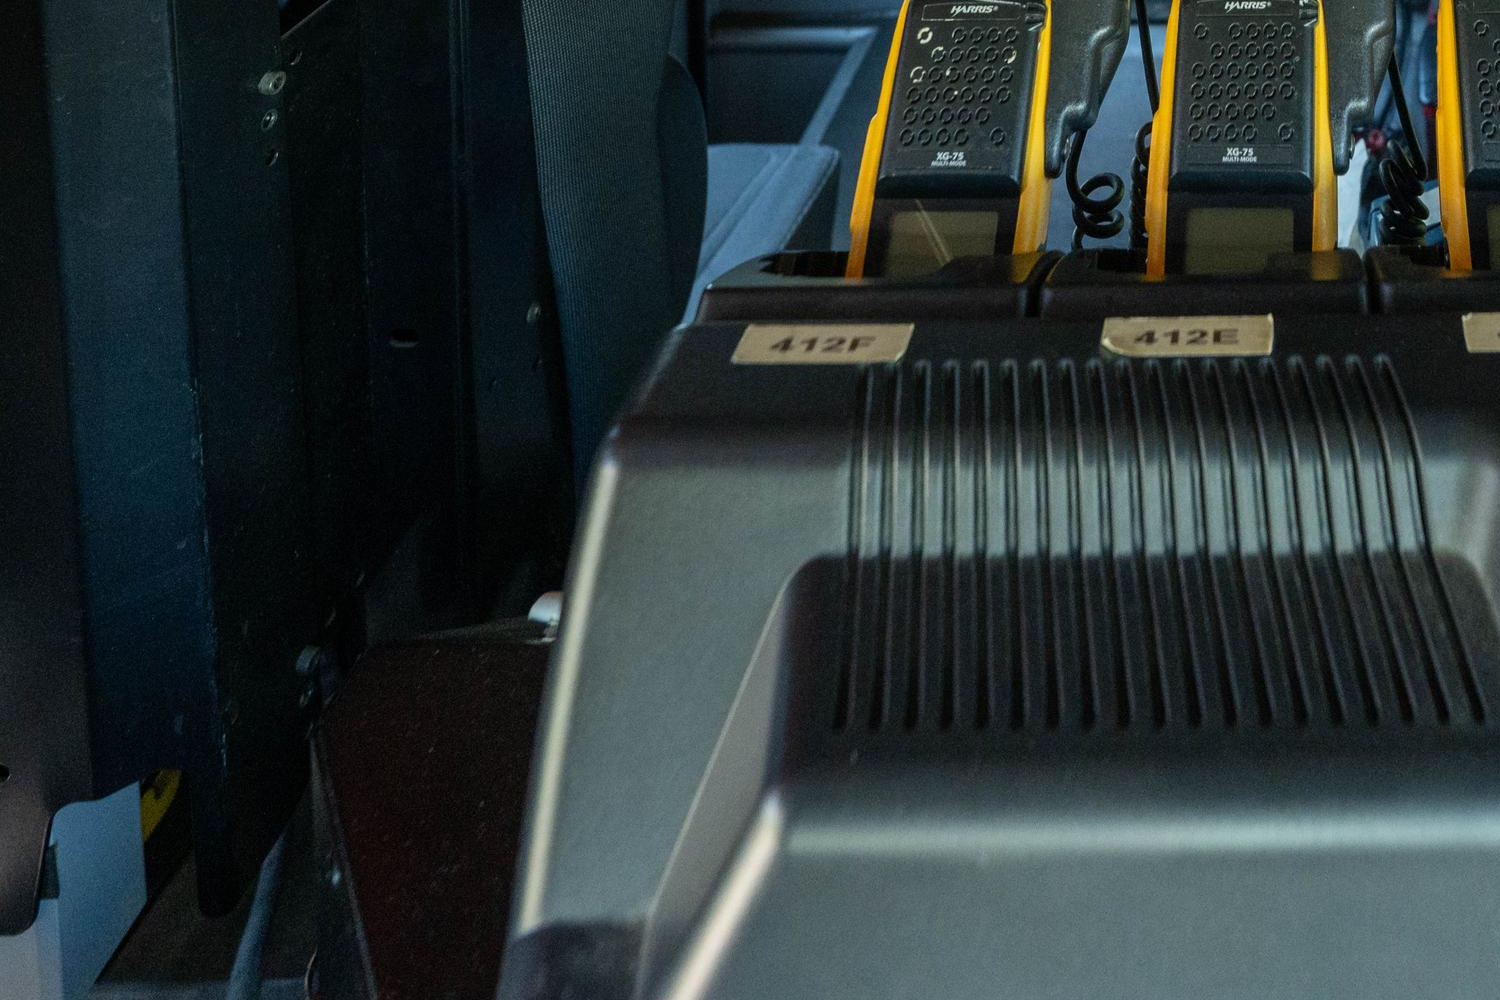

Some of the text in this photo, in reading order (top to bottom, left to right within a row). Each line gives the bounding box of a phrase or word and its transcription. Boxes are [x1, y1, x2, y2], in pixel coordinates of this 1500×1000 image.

[950, 5, 994, 17] HARRIS
[1224, 1, 1267, 14] HARRIS
[936, 151, 965, 161] XG-75
[1226, 147, 1254, 157] XG-75
[1134, 328, 1239, 345] 412E
[769, 336, 877, 353] 412F
